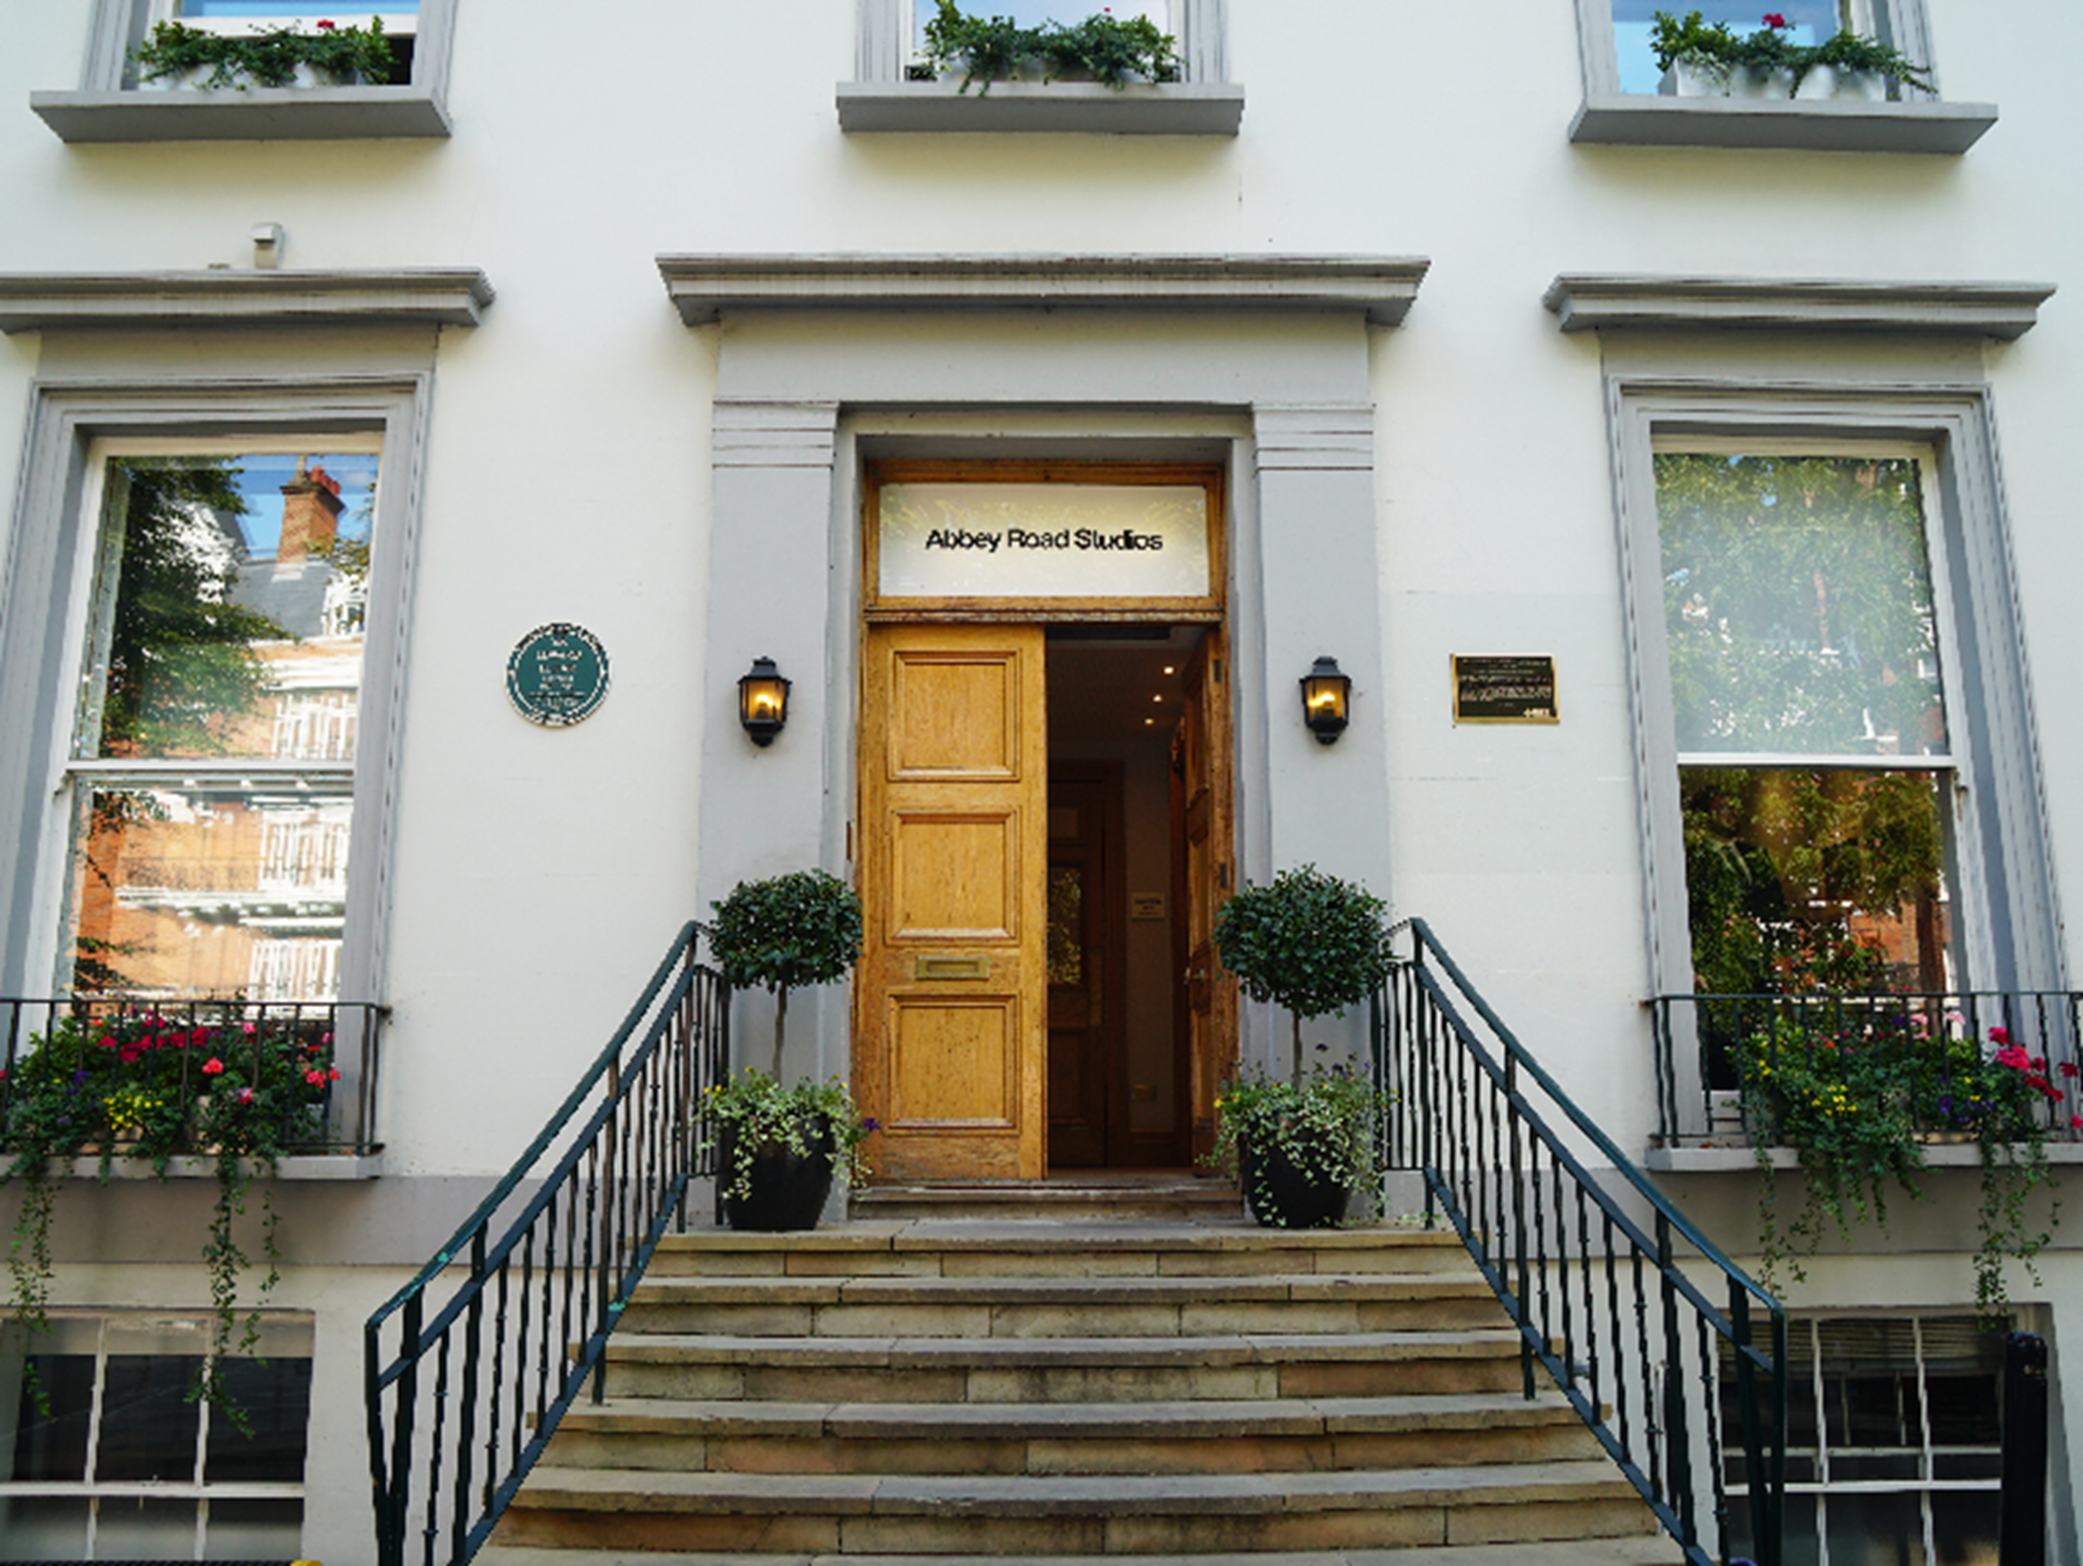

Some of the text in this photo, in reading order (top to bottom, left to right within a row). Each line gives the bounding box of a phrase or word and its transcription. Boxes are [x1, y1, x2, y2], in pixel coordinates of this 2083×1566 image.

[926, 528, 1163, 552] Abbey Road Studios
